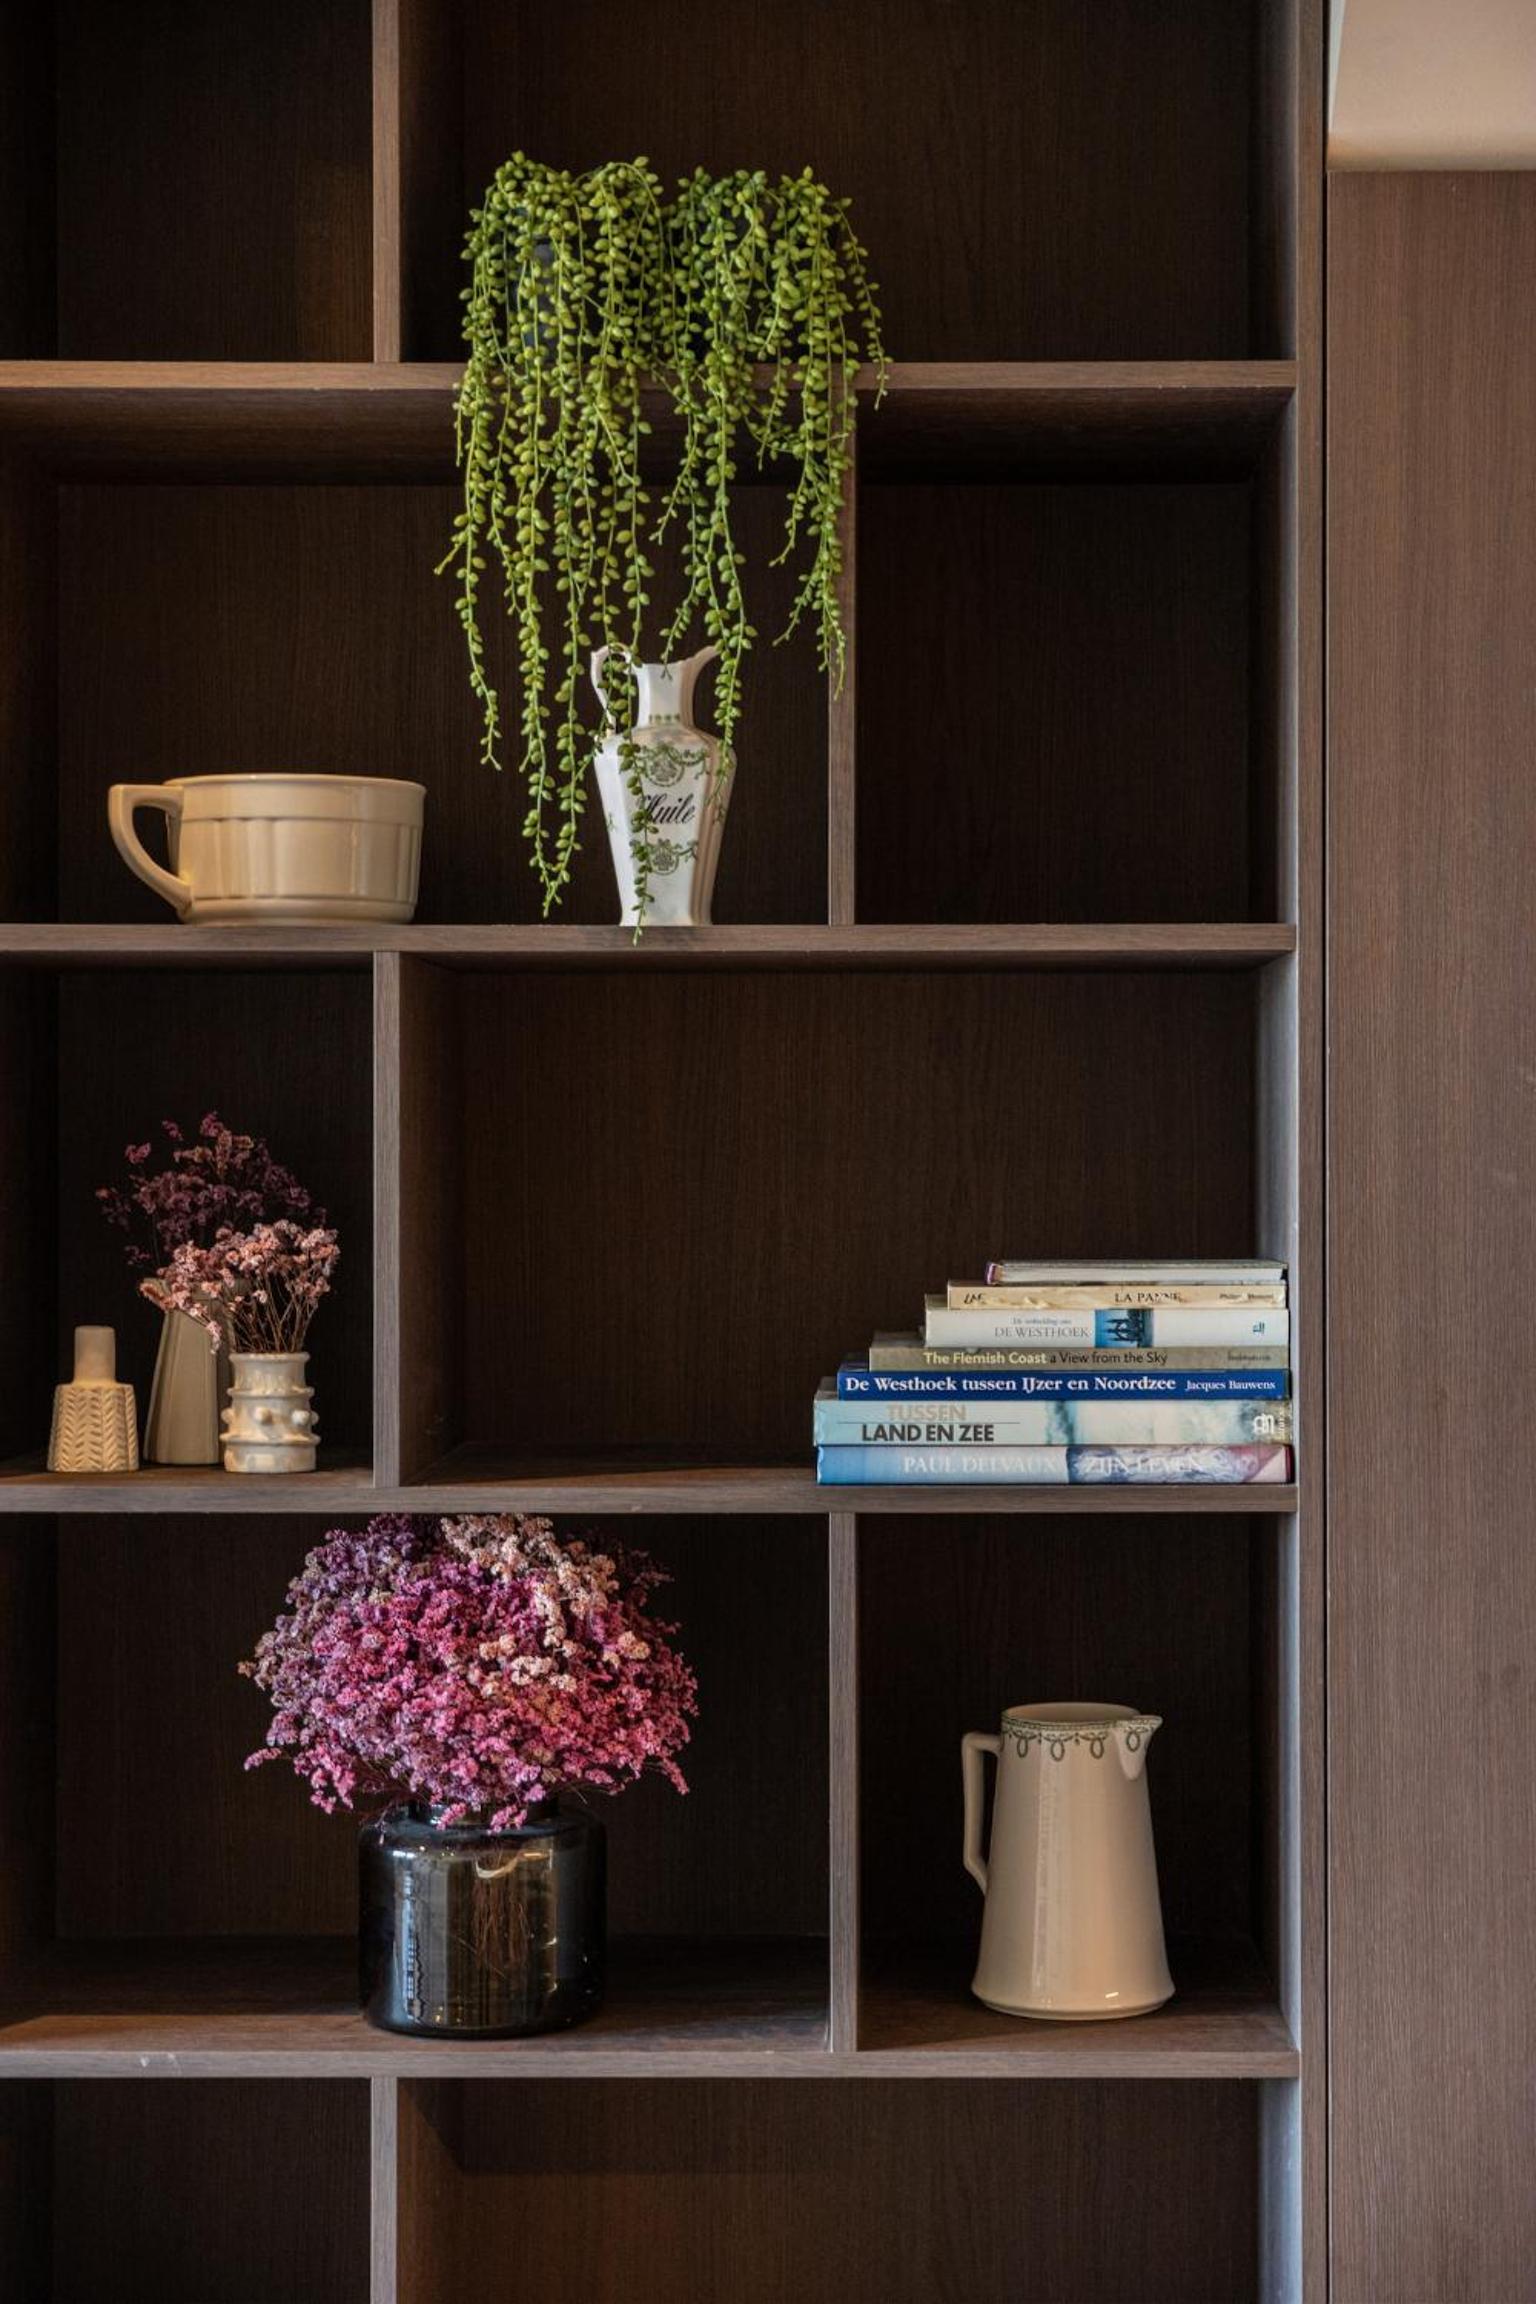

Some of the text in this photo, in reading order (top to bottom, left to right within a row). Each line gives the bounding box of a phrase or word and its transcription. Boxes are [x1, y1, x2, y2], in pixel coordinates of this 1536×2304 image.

[1115, 1292, 1132, 1303] LA
[994, 1326, 1090, 1338] DE WESTHOEK
[923, 1351, 1168, 1367] The Flemish Coast a View from the Sky
[845, 1375, 1177, 1394] De Westhoek tussen IJzer en Noordzee
[1184, 1379, 1276, 1393] Jacques Bauwens
[886, 1404, 967, 1421] TUSSEN
[862, 1424, 994, 1442] LAND EN ZEE
[903, 1456, 955, 1474] PAUL
[962, 1456, 1063, 1474] DELVAUX
